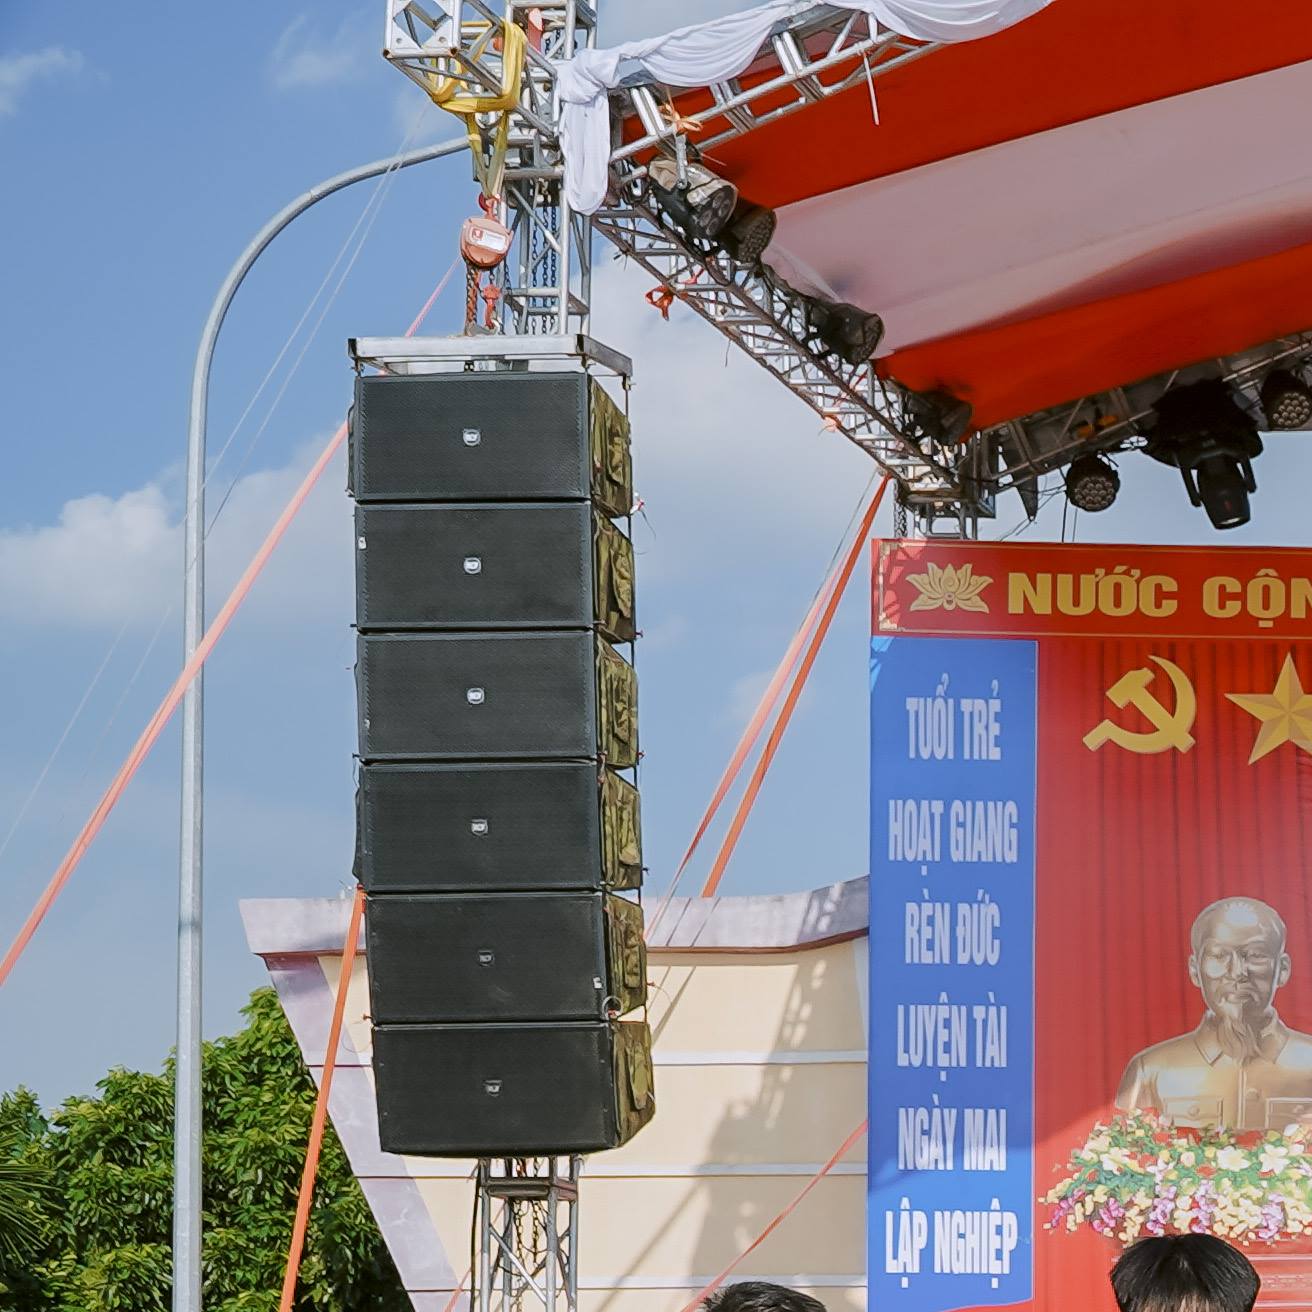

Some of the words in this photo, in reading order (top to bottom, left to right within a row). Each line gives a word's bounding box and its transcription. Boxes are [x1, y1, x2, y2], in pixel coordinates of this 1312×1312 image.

[1008, 566, 1177, 617] NƯỚC
[906, 673, 954, 760] TUỔI
[961, 680, 1001, 760] TRẺ
[889, 799, 943, 875] HOẠT
[950, 800, 1017, 863] GIANG
[906, 889, 950, 964] RÈN
[956, 890, 1000, 965] ĐỨC
[898, 992, 966, 1081] LUYỆN
[973, 992, 1007, 1067] TÀI
[899, 1094, 957, 1170] NGÀY
[964, 1109, 1006, 1171] MAI
[886, 1198, 927, 1288] LẬP
[934, 1199, 1017, 1288] NGHIỆP
